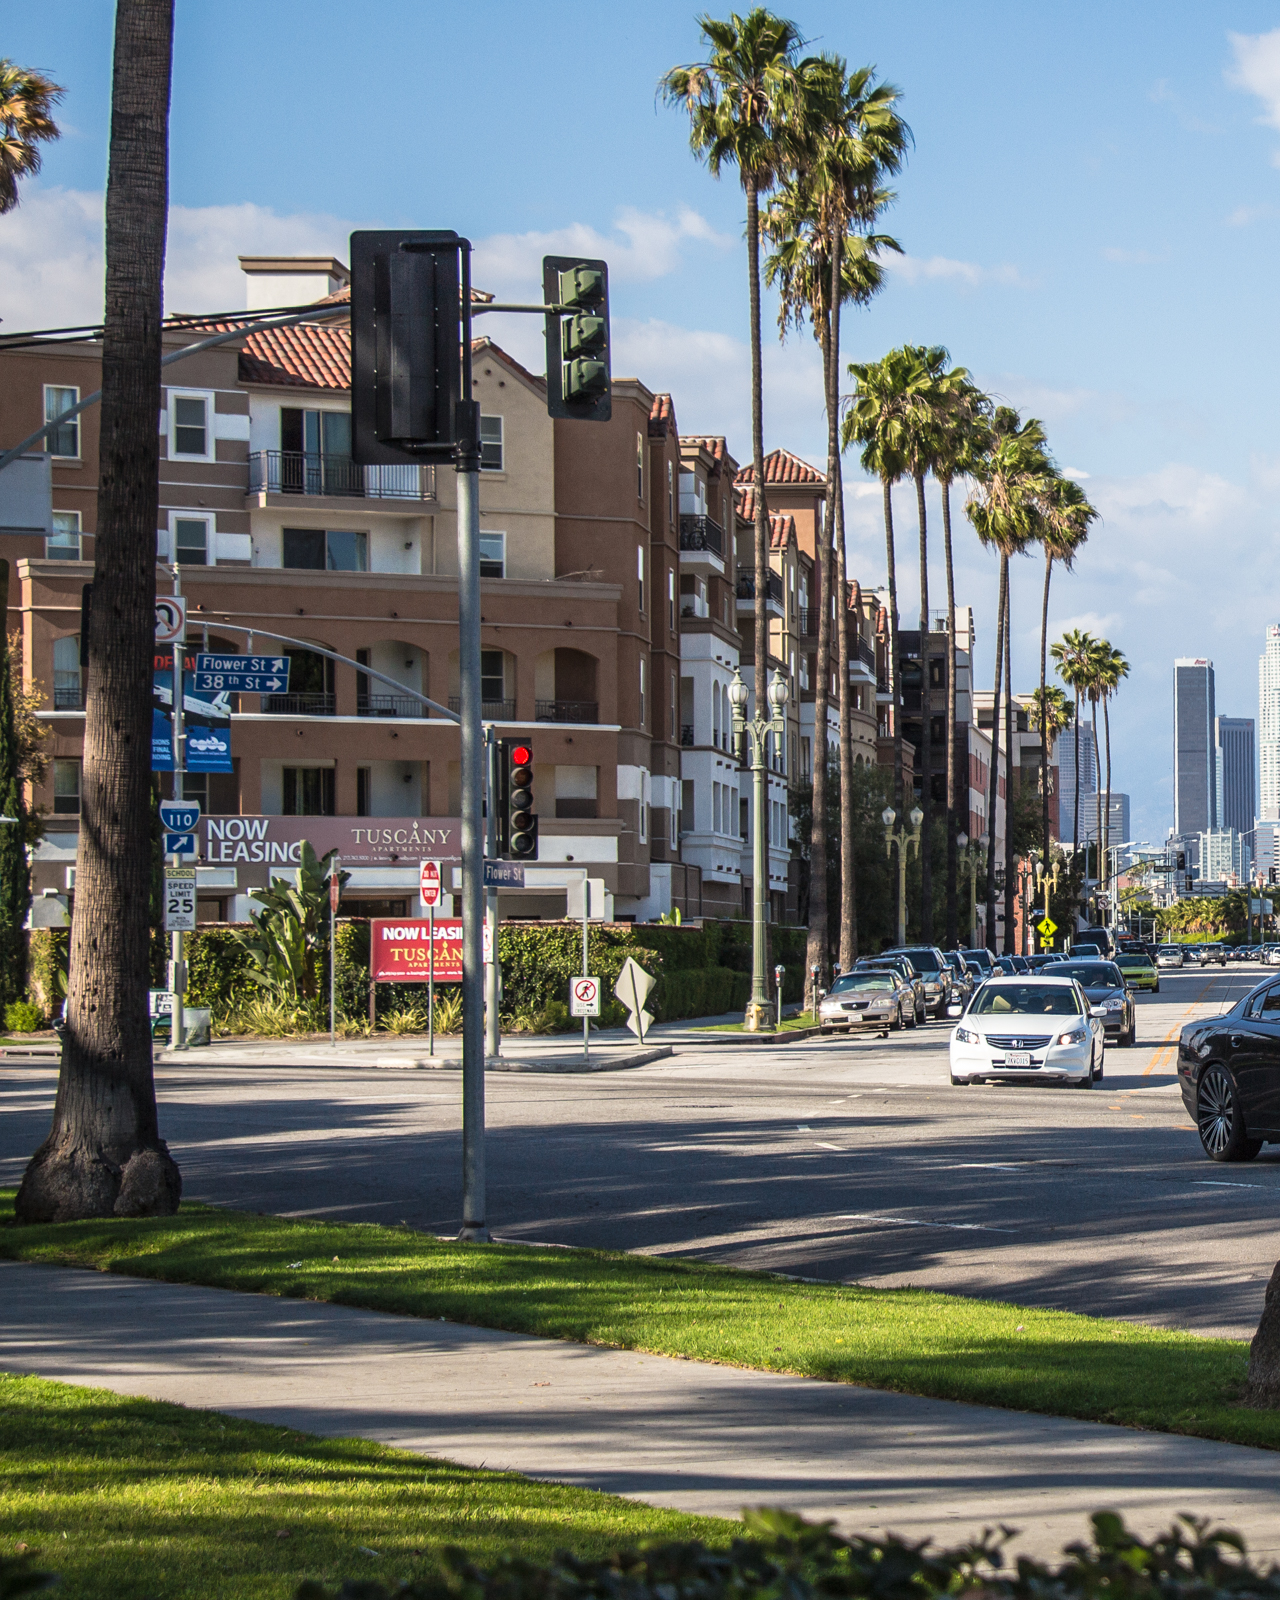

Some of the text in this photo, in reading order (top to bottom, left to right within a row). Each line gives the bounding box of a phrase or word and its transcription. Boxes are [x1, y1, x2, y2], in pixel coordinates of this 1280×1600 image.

[203, 657, 247, 671] Flower
[251, 658, 266, 671] St
[202, 675, 224, 689] 38
[245, 677, 260, 689] St
[169, 814, 192, 826] 110
[207, 819, 269, 840] NOW
[351, 829, 452, 845] TUSCANY
[207, 841, 302, 863] LEASING
[486, 866, 522, 881] Flower St
[424, 889, 437, 897] ENTER
[168, 899, 194, 913] 25
[382, 926, 463, 940] NOW LEASI
[390, 948, 463, 961] TUSCAN
